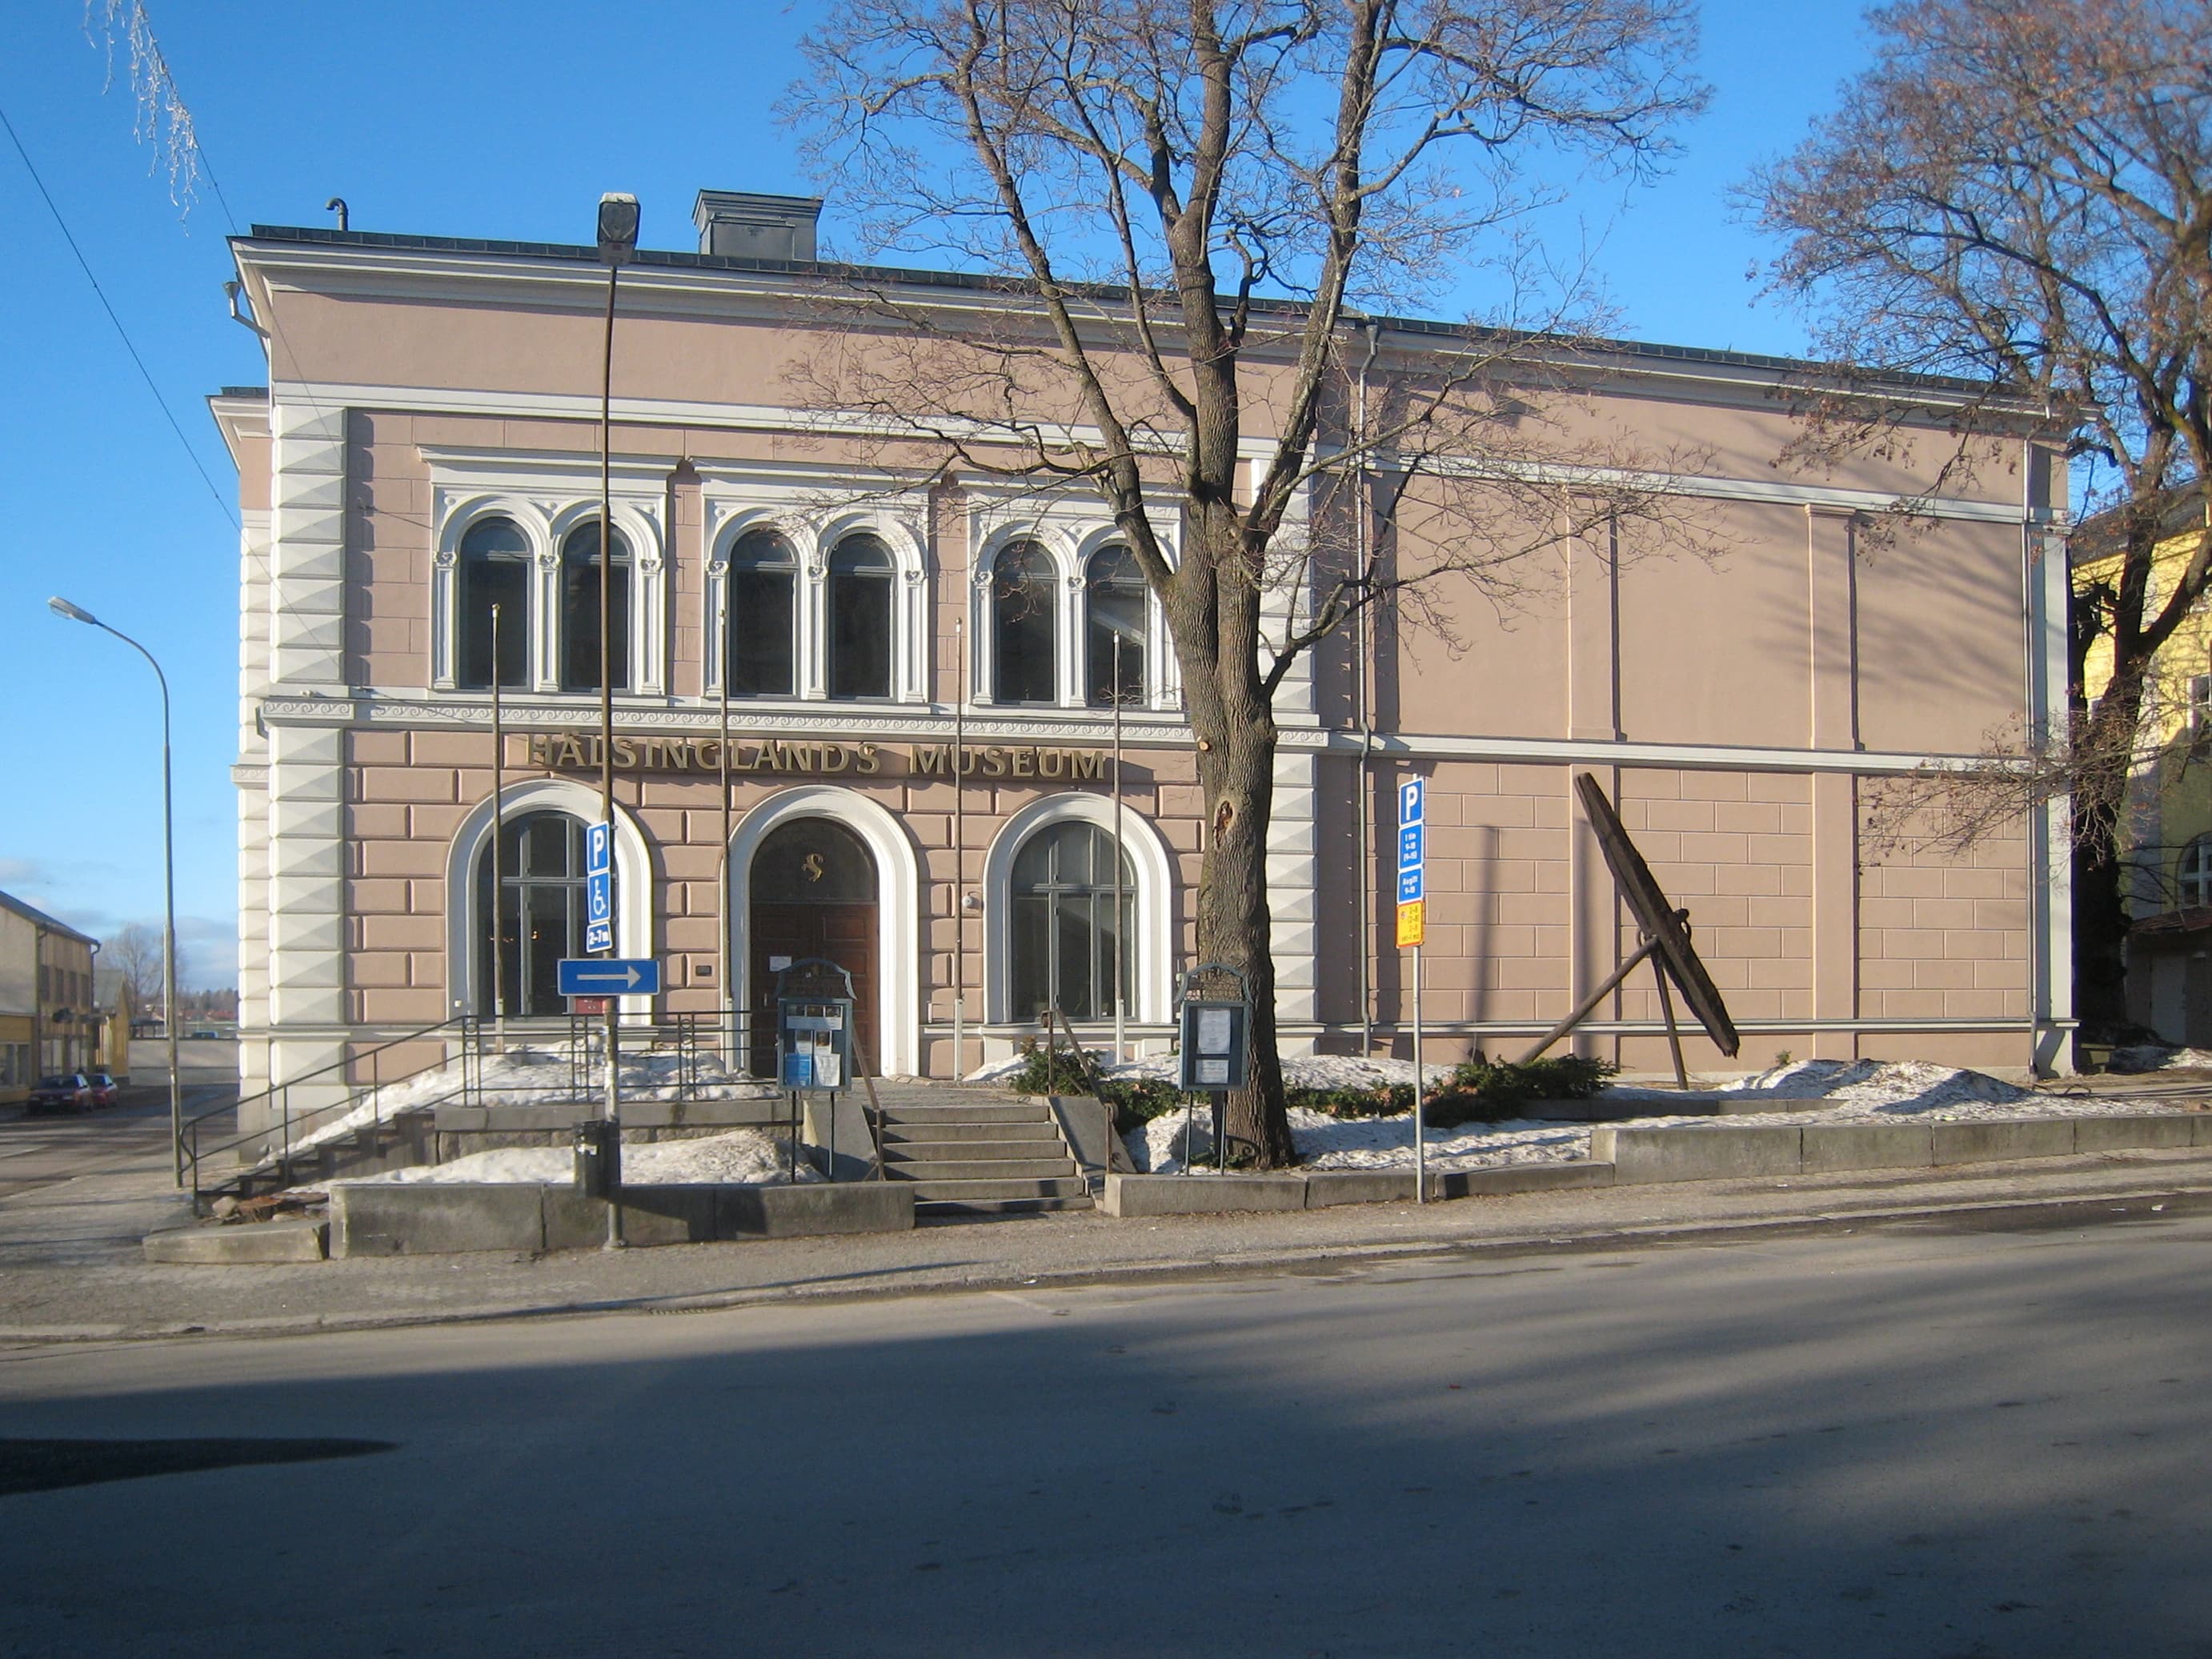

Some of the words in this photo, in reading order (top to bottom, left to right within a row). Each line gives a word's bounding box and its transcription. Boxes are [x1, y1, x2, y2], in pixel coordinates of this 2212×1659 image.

[526, 730, 881, 775] HÄLSINGLANDS
[909, 744, 1105, 779] MUSEUM
[1405, 784, 1419, 821] P
[593, 828, 605, 867] P
